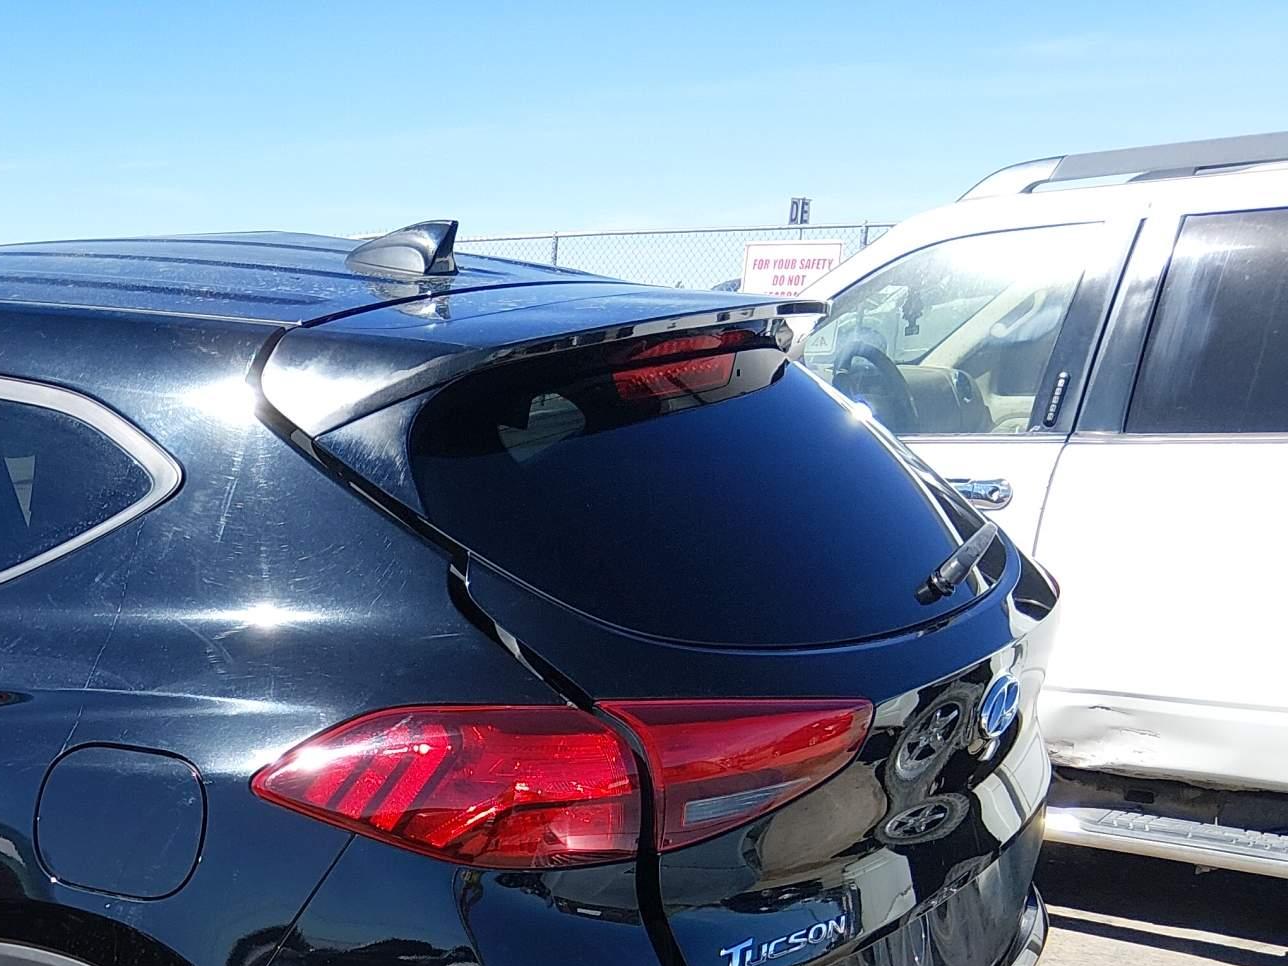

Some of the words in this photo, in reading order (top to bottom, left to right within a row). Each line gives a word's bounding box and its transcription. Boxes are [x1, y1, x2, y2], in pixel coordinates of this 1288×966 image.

[752, 258, 770, 270] FOR
[798, 258, 834, 270] SAFETY
[772, 275, 785, 286] DO
[787, 275, 807, 286] NOT
